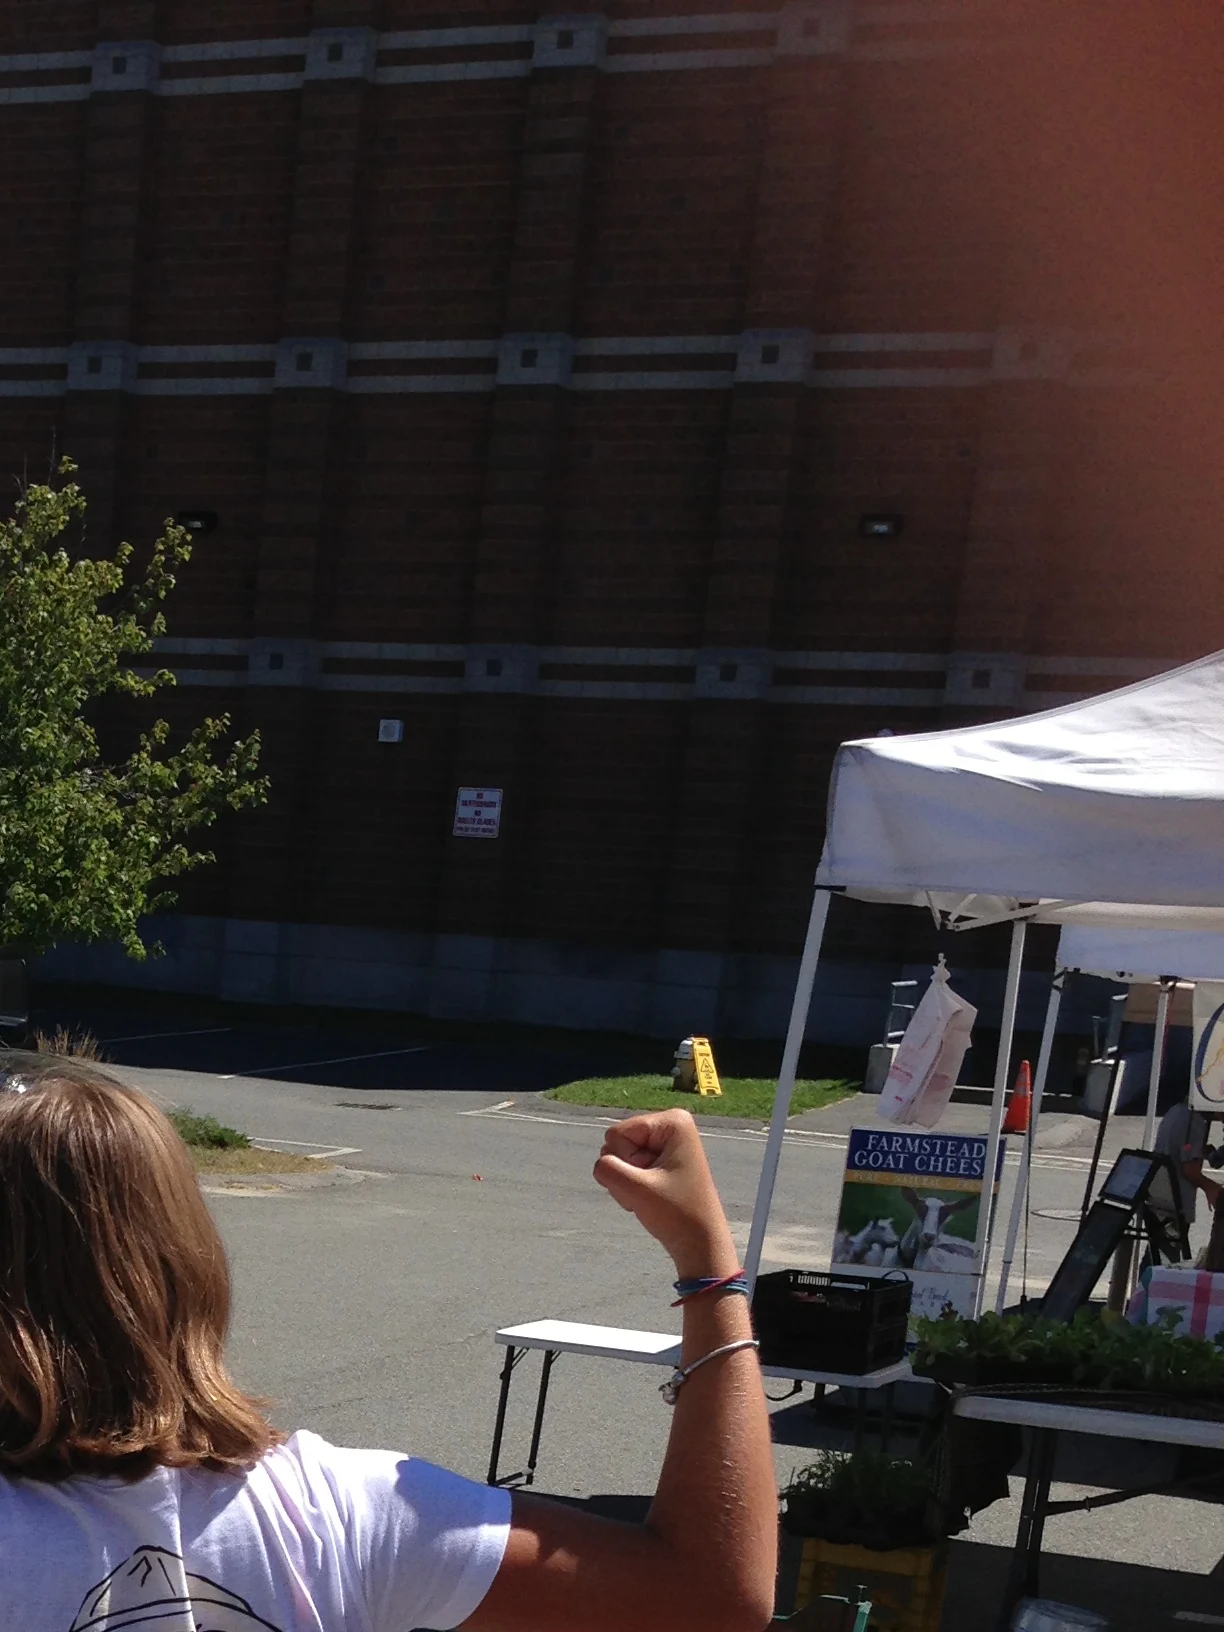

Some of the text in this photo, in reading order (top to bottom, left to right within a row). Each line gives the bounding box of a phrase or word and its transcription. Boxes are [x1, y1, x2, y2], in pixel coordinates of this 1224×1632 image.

[867, 1134, 986, 1158] FARMSTEAD
[854, 1150, 985, 1176] GOAT CHEES
